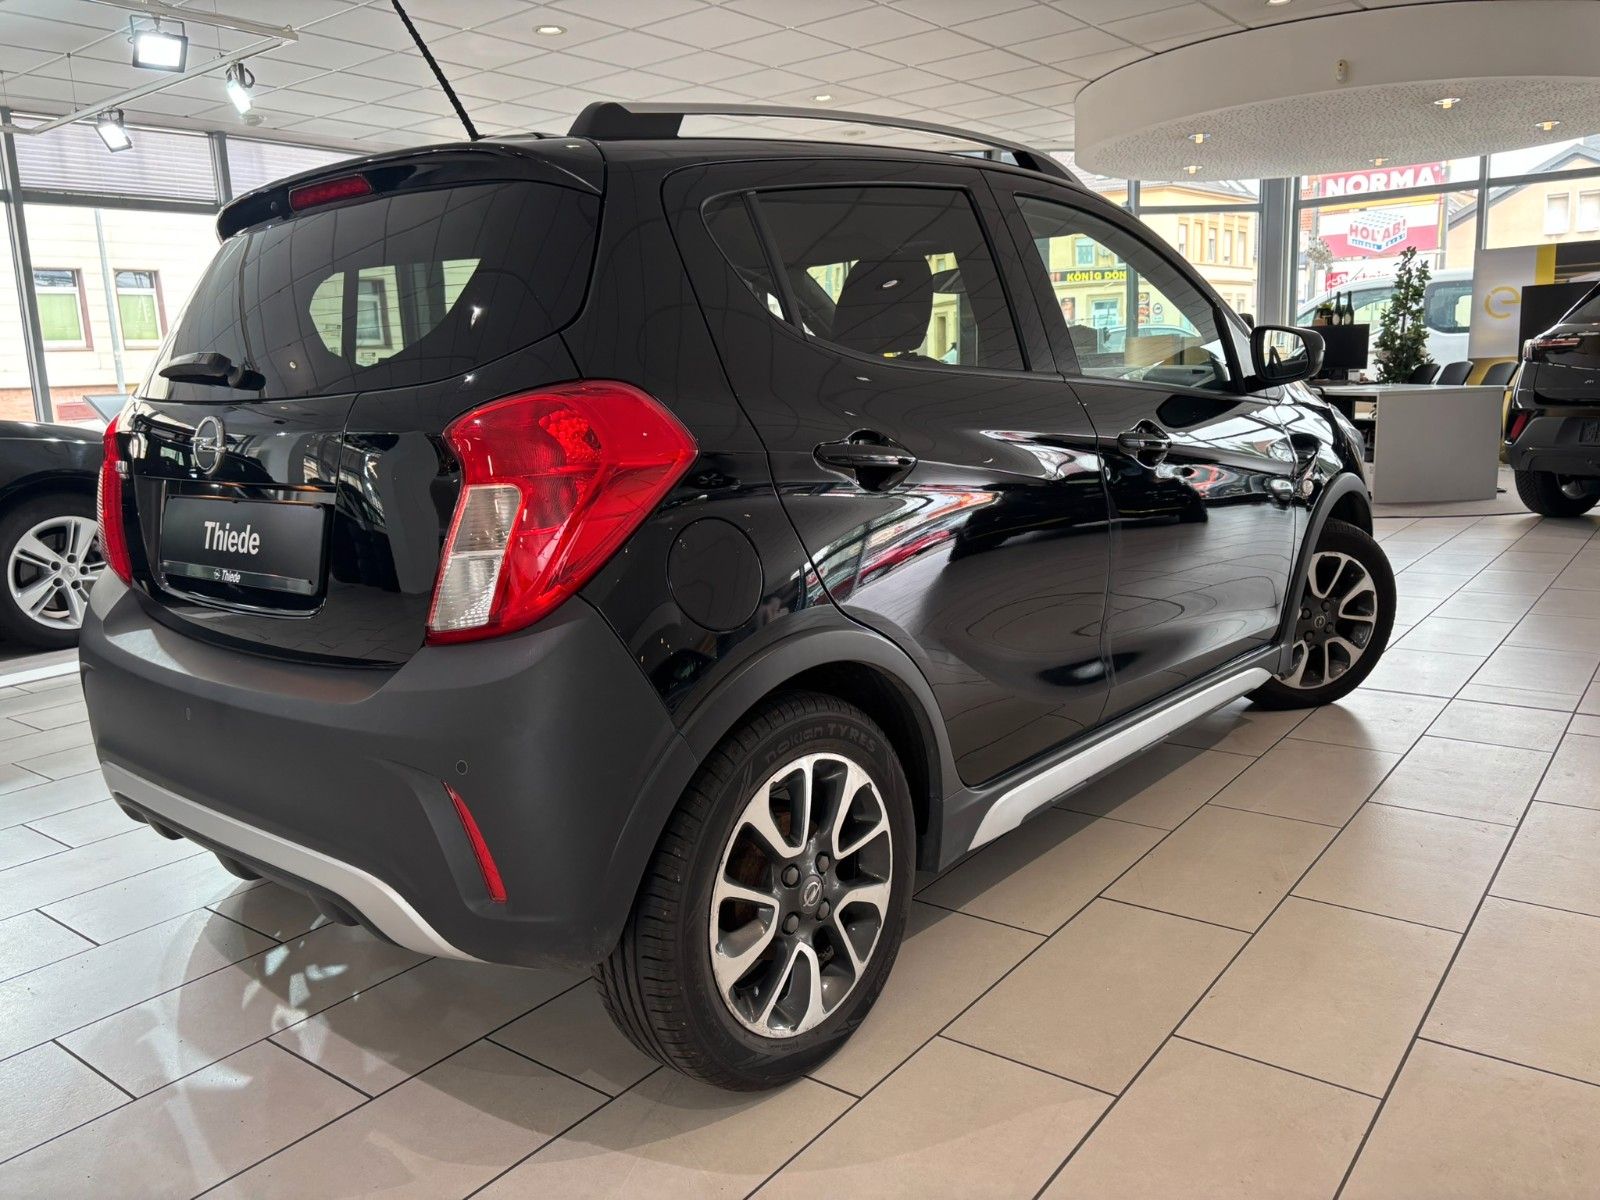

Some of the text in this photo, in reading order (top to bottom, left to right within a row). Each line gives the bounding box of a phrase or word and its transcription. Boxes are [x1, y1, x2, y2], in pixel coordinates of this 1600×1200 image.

[1325, 166, 1437, 197] NORMA
[204, 521, 260, 555] Thiede
[222, 569, 241, 583] Thiede
